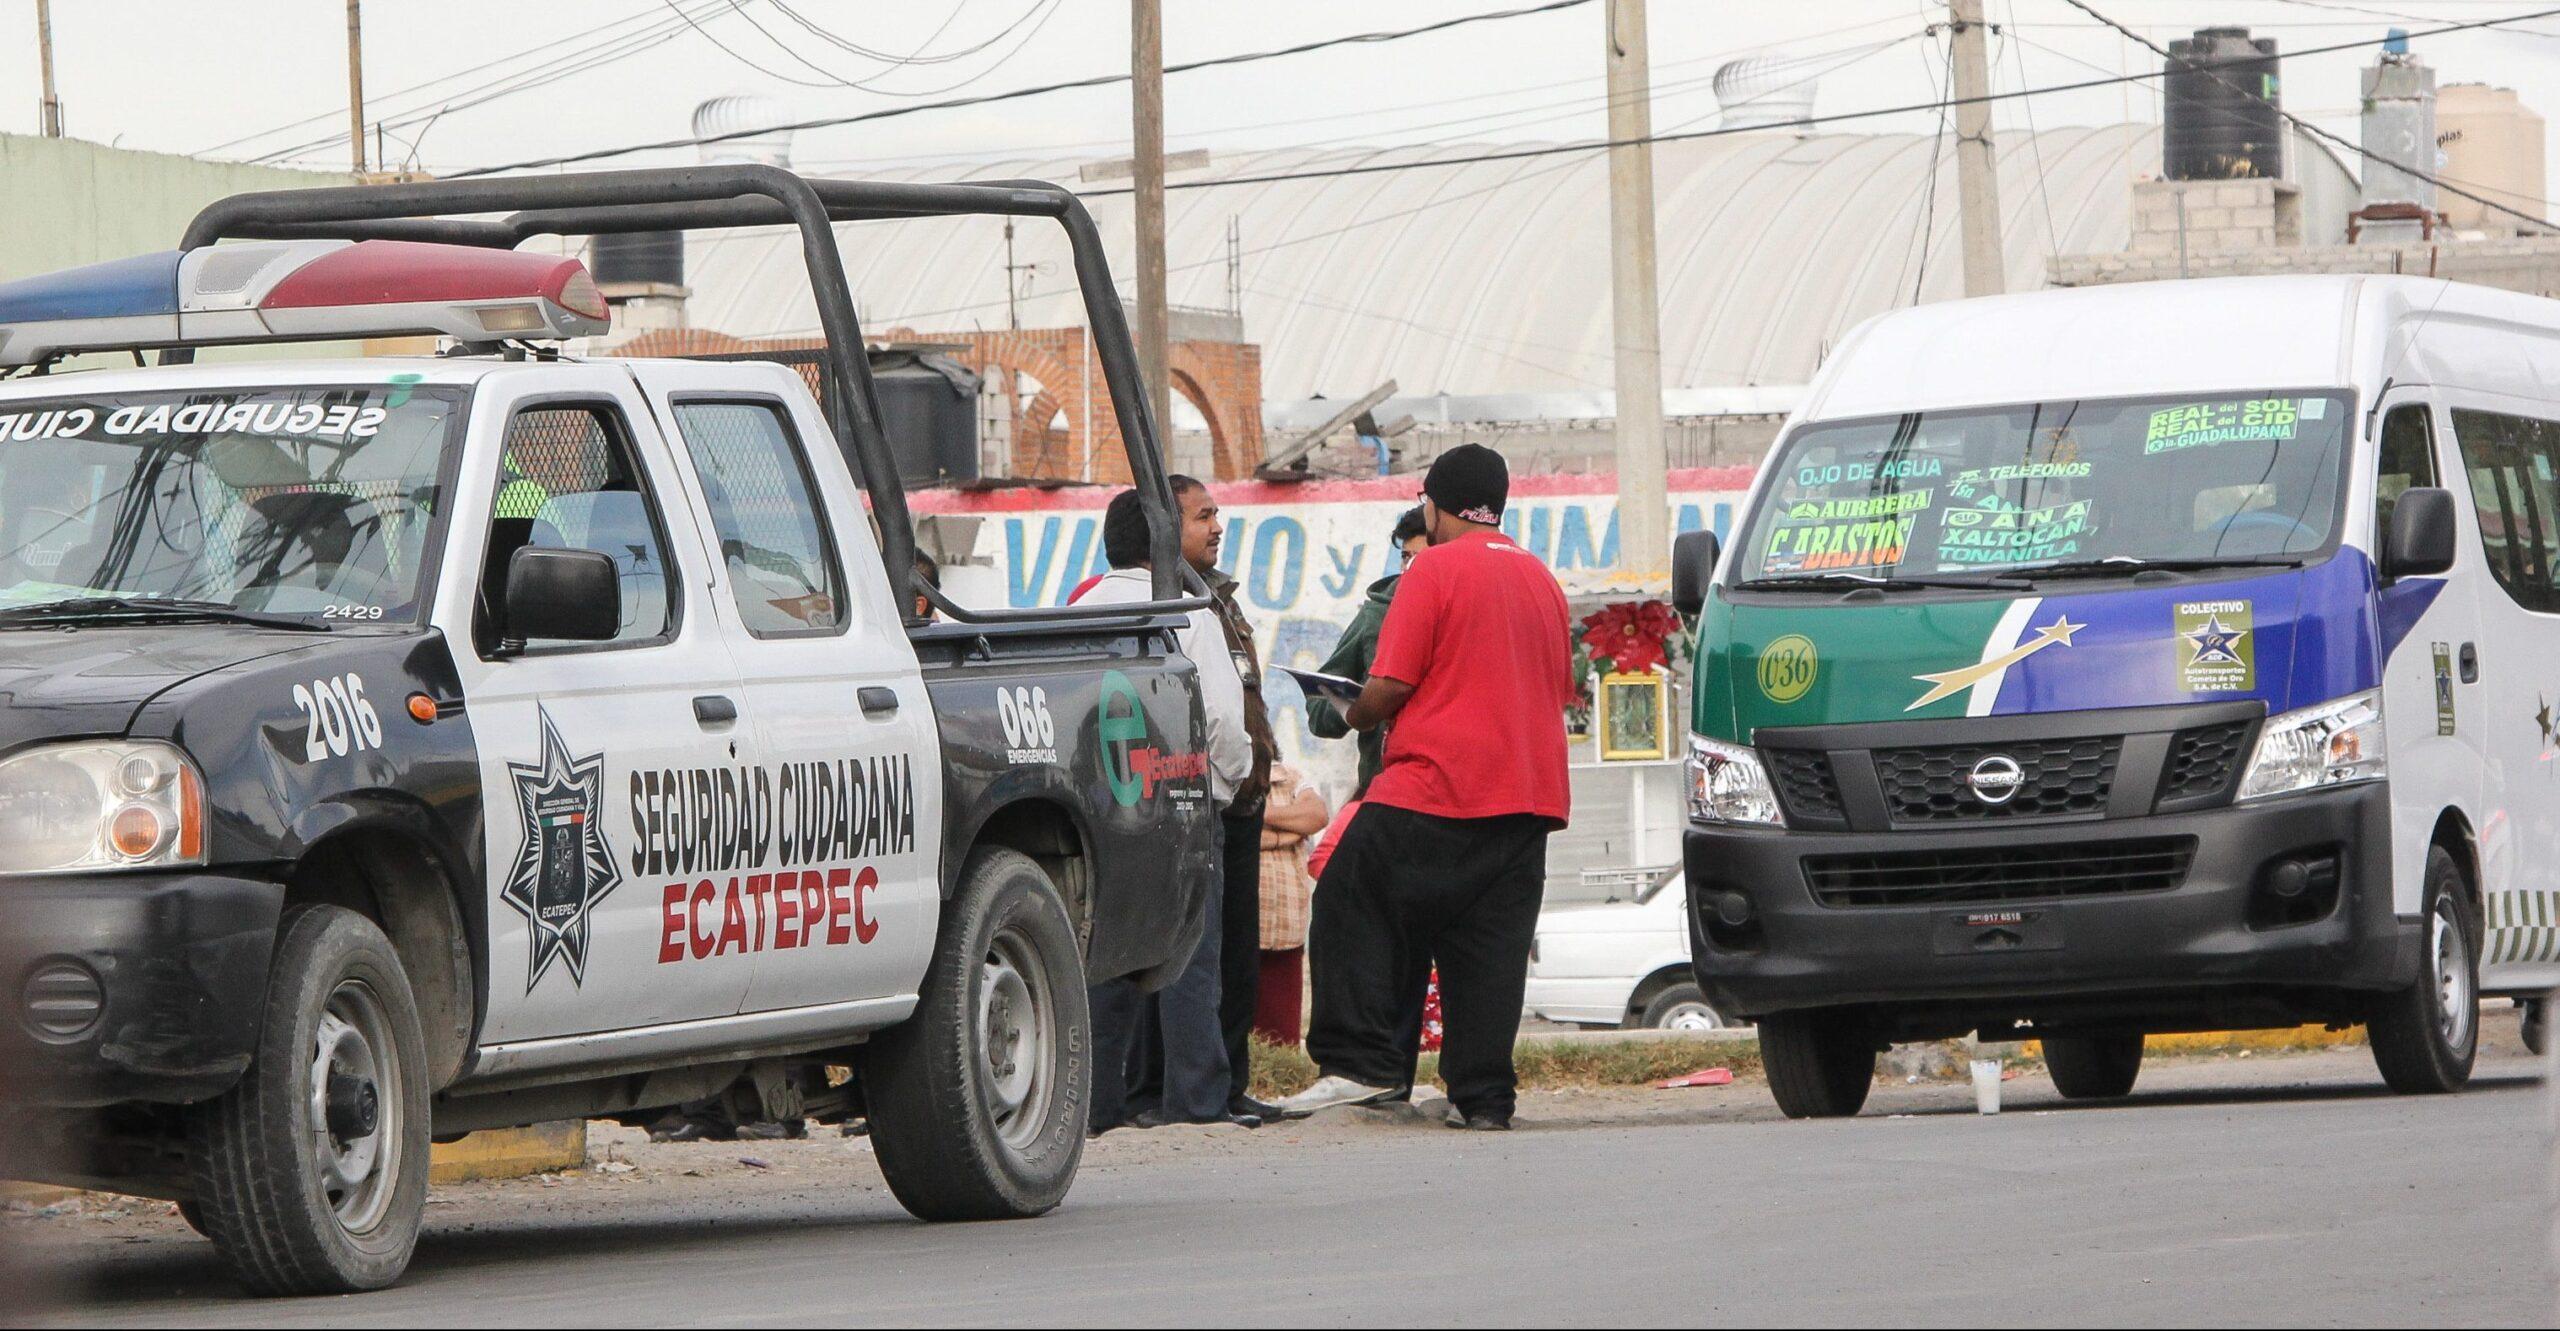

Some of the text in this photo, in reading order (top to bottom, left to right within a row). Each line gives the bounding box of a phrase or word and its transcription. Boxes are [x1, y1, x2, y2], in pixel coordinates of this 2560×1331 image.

[2150, 412, 2297, 440] REAL del CID
[2153, 399, 2297, 428] REAL del SOL
[2177, 424, 2292, 447] GUADALUPANA
[1800, 465, 1842, 486] OJO
[1847, 463, 1877, 481] DE
[1881, 458, 1942, 478] AGUA
[1988, 462, 2092, 480] TELEFONOS
[1820, 490, 1927, 518] AURRERA
[1943, 517, 2083, 546] XALTOCAN
[1937, 540, 2077, 562] TONANITLA
[323, 604, 383, 620] 2429
[2181, 602, 2245, 615] COLECTIVO
[1765, 646, 1809, 690] 036
[2229, 674, 2244, 682] Oro
[292, 672, 383, 763] 2016
[996, 686, 1055, 749] 066
[1008, 749, 1058, 764] EMERGENCIAS
[629, 753, 915, 878] SEGURIDAD CIUDADANA
[541, 903, 577, 919] ECATEPEC
[657, 865, 879, 965] ECATEPEC
